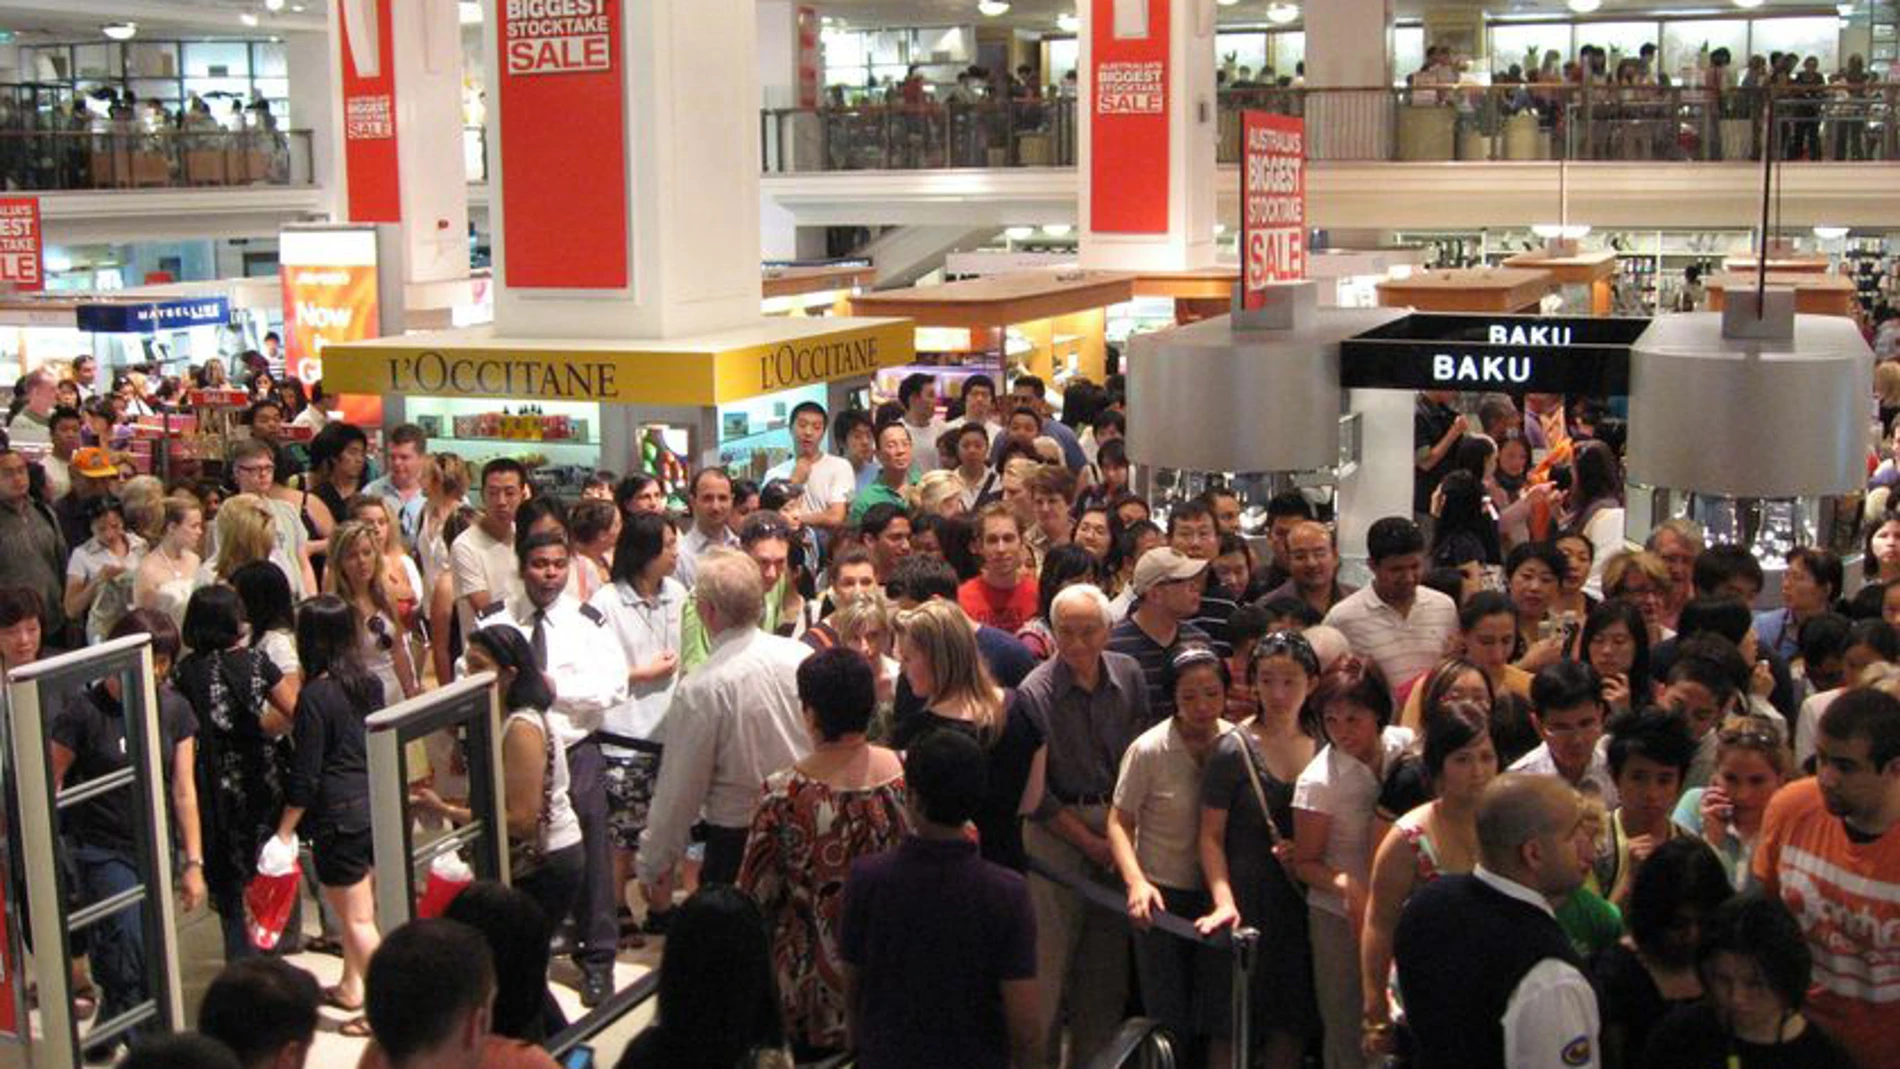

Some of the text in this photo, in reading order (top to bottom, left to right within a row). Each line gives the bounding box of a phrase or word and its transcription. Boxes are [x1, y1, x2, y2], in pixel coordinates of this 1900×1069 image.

[507, 0, 604, 19] BIGGEST
[507, 16, 609, 37] STOCKTAKE
[509, 38, 608, 71] SALE
[1099, 70, 1163, 83] BIGGEST
[1100, 95, 1161, 111] SALE
[348, 122, 391, 138] SALE
[1249, 154, 1301, 193] BIGGEST
[1249, 196, 1302, 224] STOCKTAKE
[0, 237, 36, 251] TAKE
[0, 255, 35, 279] LE
[1250, 231, 1301, 286] SALE
[137, 303, 219, 320] MAYBELLINE
[295, 300, 352, 328] Now
[1489, 325, 1571, 346] BAKU
[389, 352, 619, 398] L'OCCITANE
[761, 337, 878, 389] L'OCCITANE
[1433, 354, 1531, 382] BAKU
